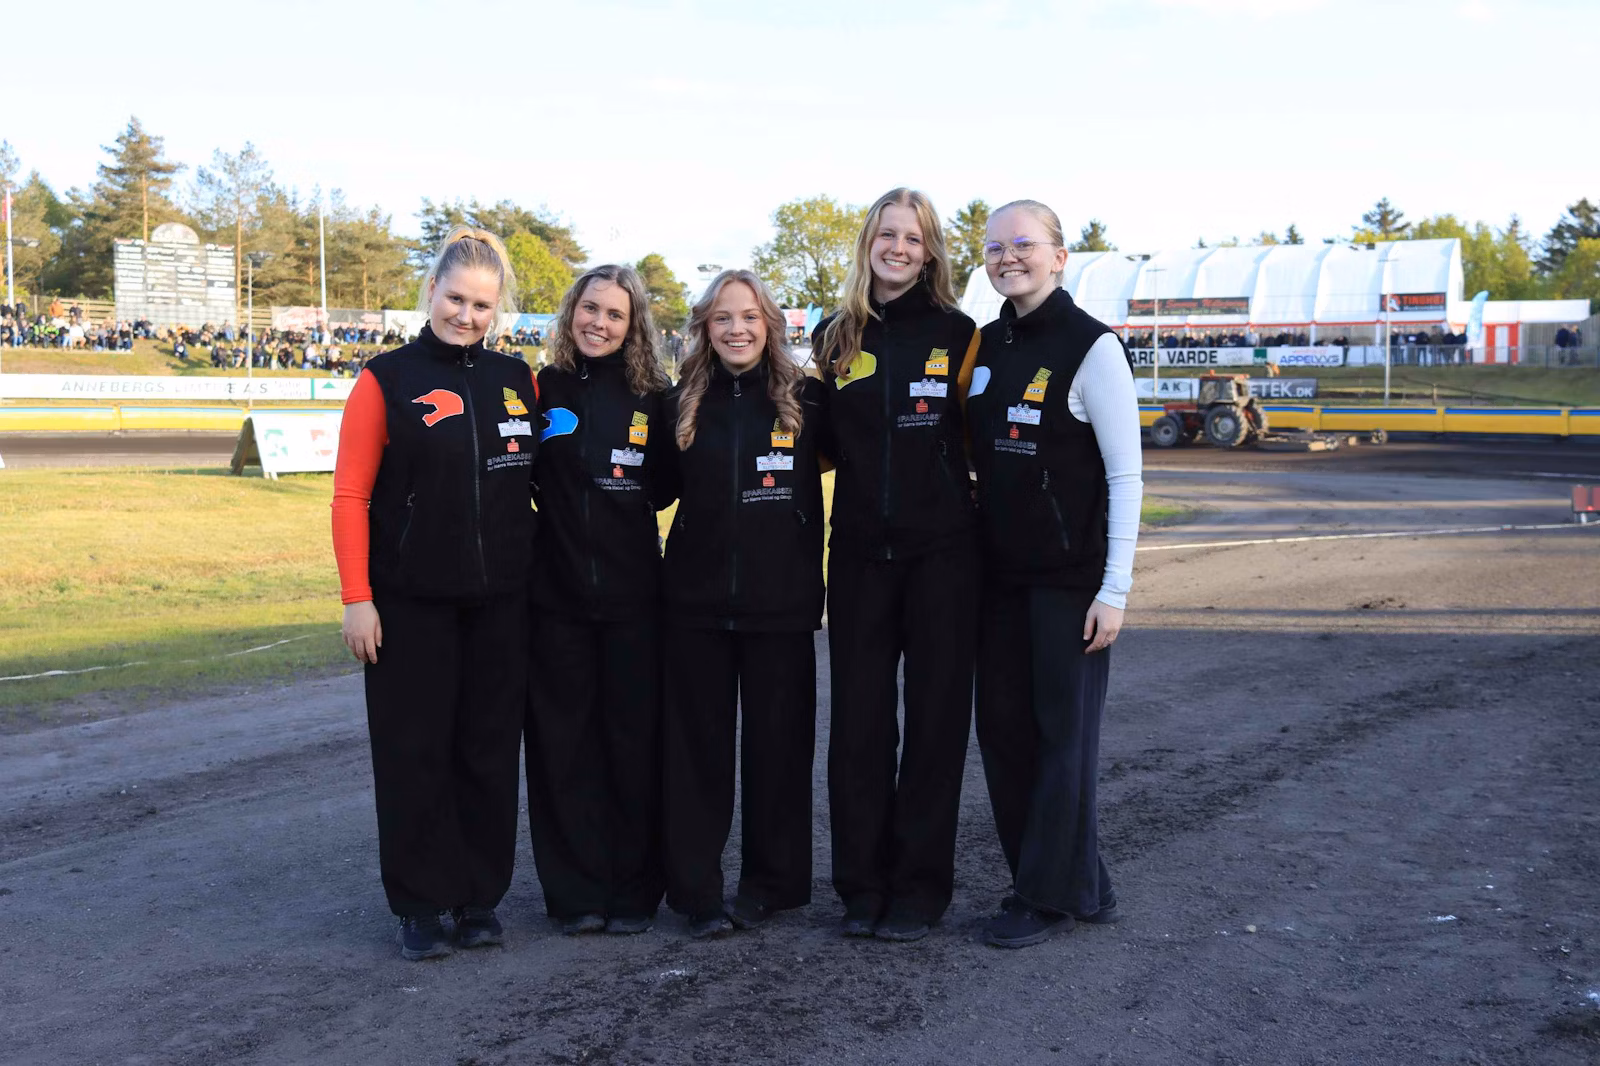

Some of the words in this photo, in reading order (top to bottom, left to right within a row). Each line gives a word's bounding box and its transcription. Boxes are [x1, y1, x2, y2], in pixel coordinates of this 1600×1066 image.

[1131, 350, 1160, 364] ARD
[1167, 350, 1218, 364] VARDE
[61, 380, 166, 393] ANNEBERGS
[1249, 382, 1314, 397] ETEK.DK
